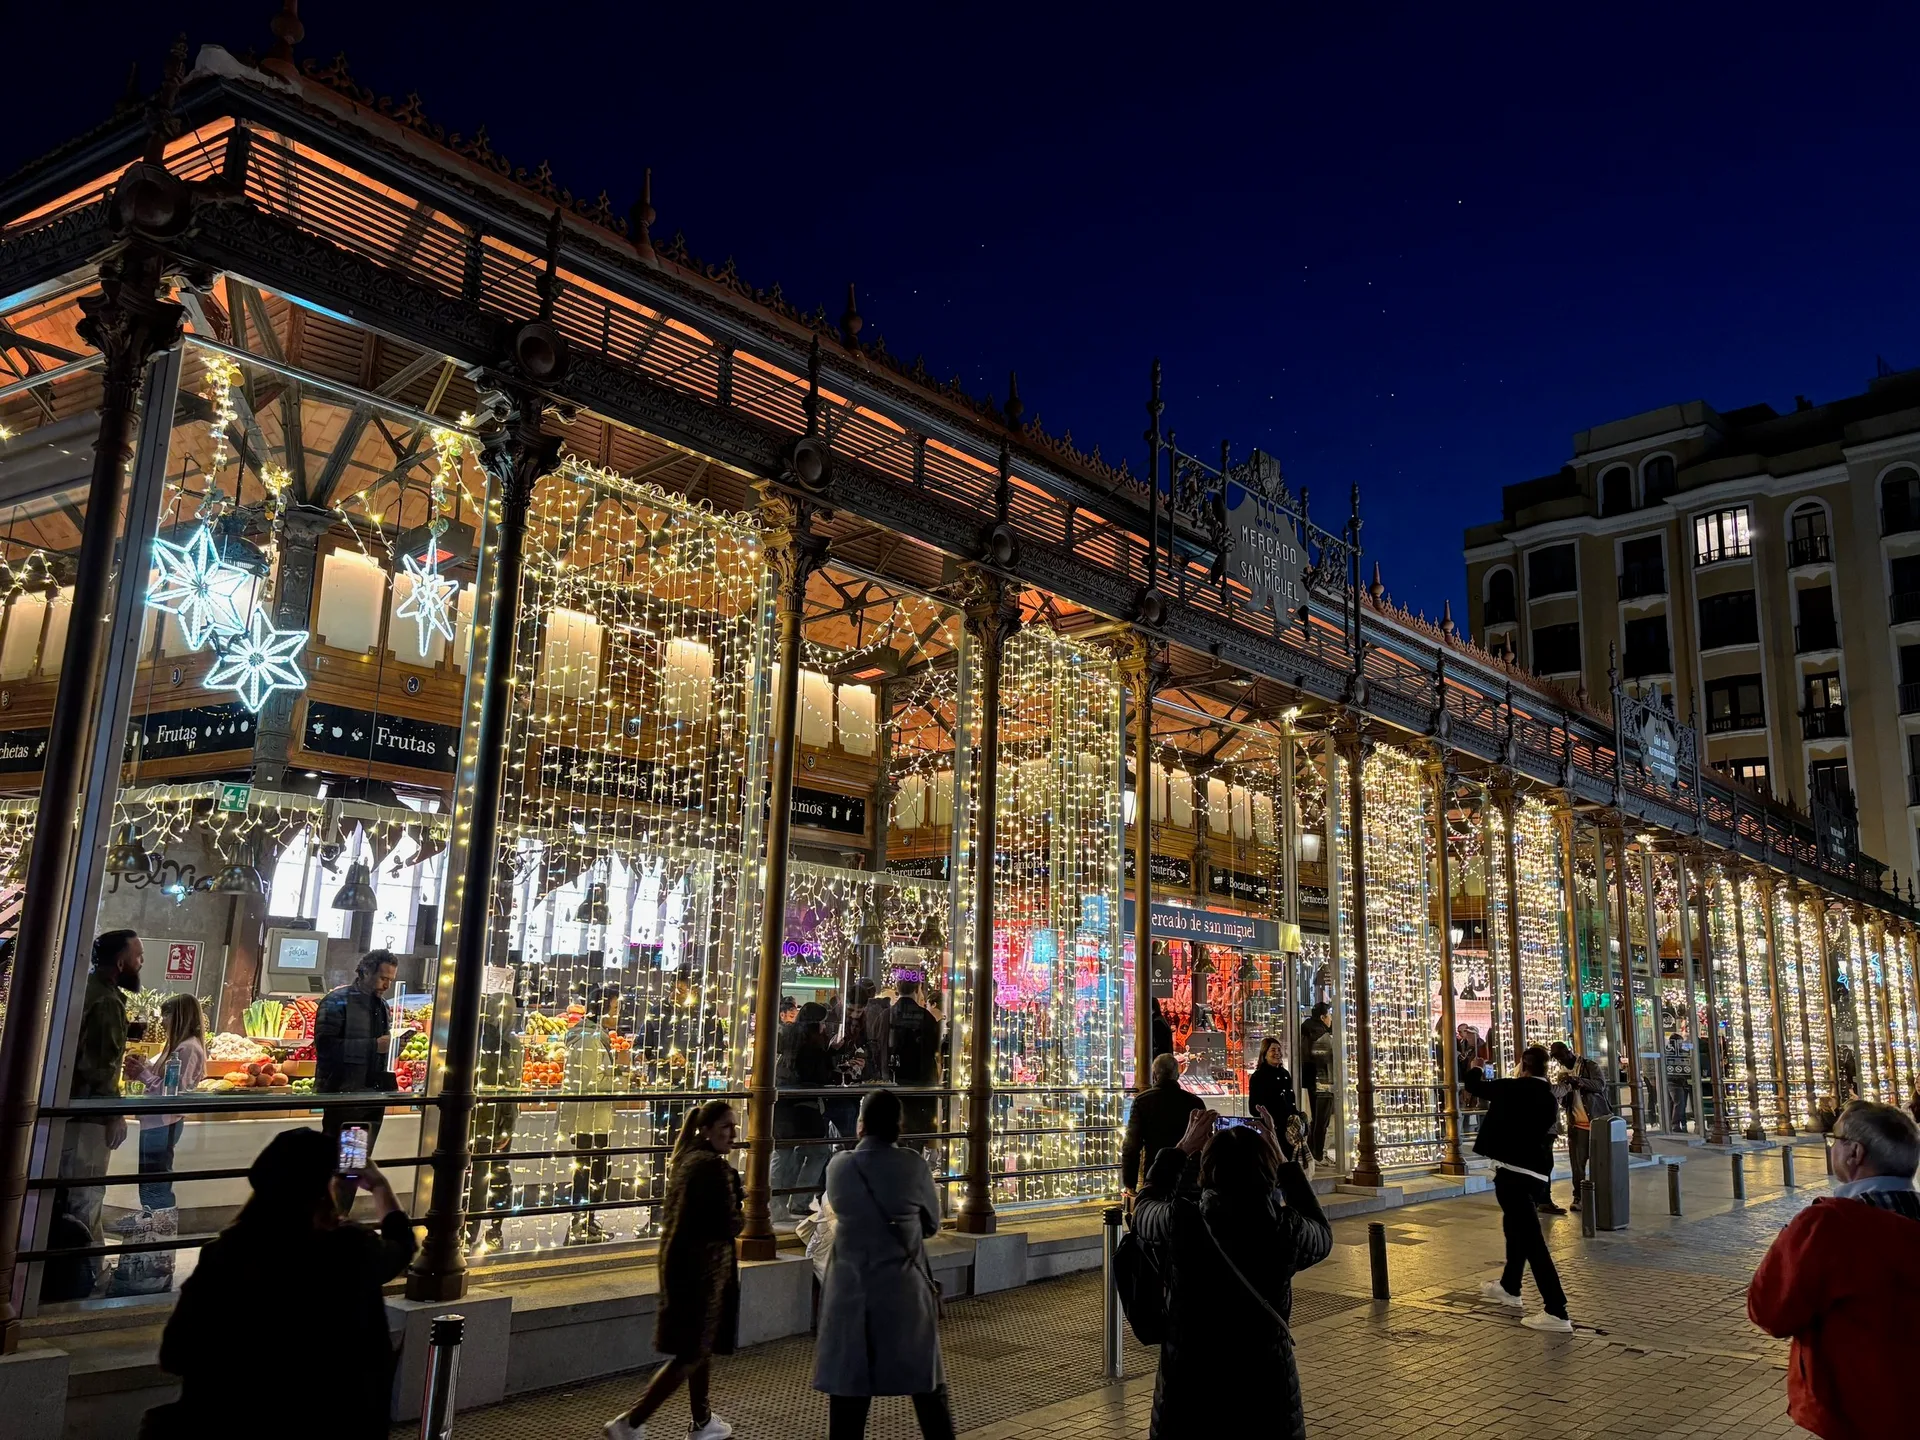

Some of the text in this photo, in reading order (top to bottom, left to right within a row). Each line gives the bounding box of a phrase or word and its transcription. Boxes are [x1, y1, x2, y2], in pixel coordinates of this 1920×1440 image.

[1241, 525, 1297, 565] MERCADO
[1240, 561, 1261, 585] SAN
[1263, 555, 1277, 571] DE
[156, 725, 197, 743] Frutas
[375, 726, 436, 755] Frutas
[790, 801, 823, 816] umos
[1229, 876, 1253, 892] Bocatas
[1151, 911, 1256, 942] ercado de san miguel
